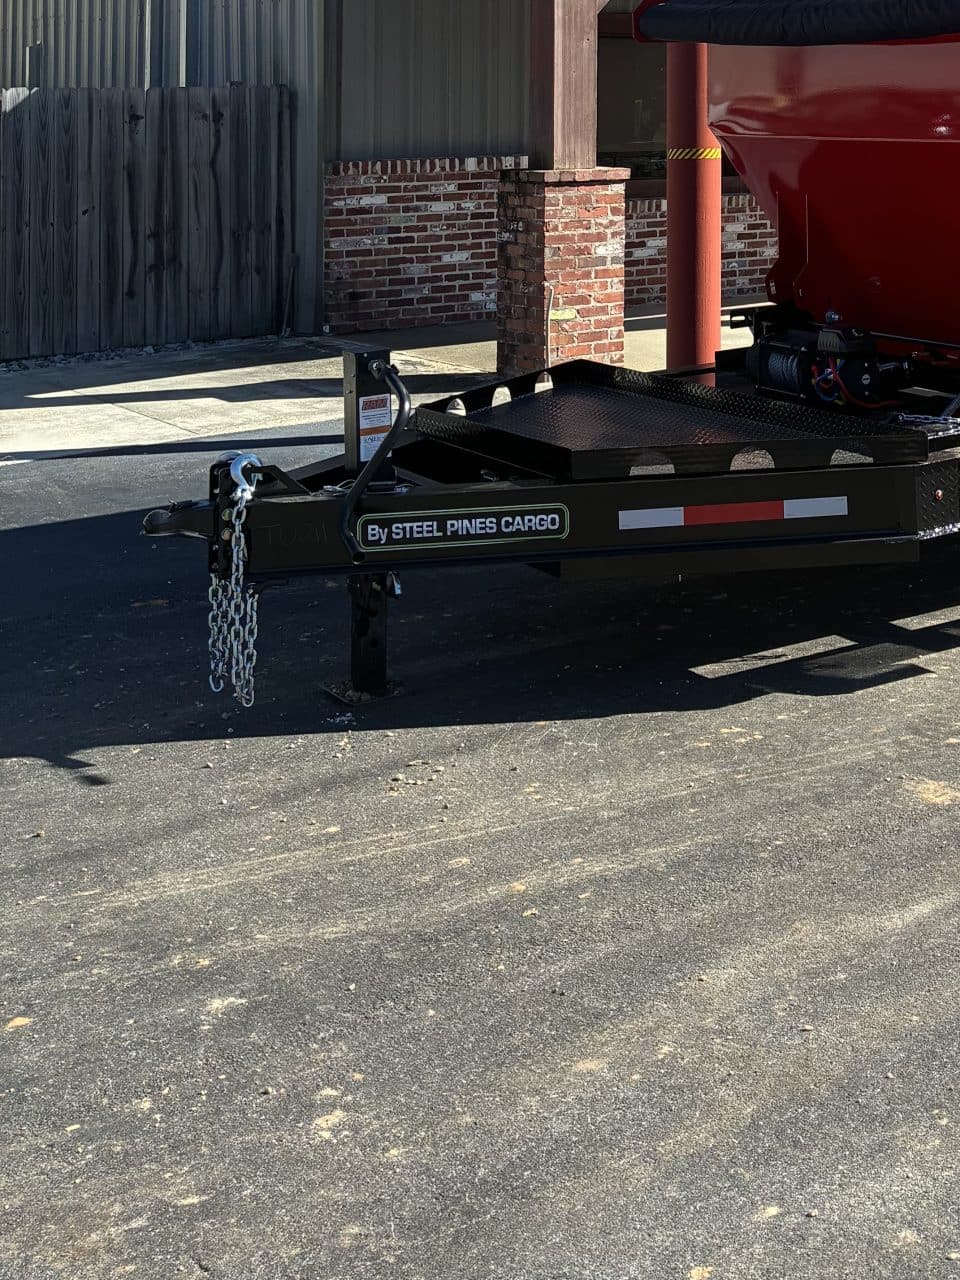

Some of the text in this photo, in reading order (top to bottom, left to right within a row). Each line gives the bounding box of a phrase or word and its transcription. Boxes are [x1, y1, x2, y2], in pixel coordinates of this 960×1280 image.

[367, 514, 560, 544] By STEEL PINES CARGO
